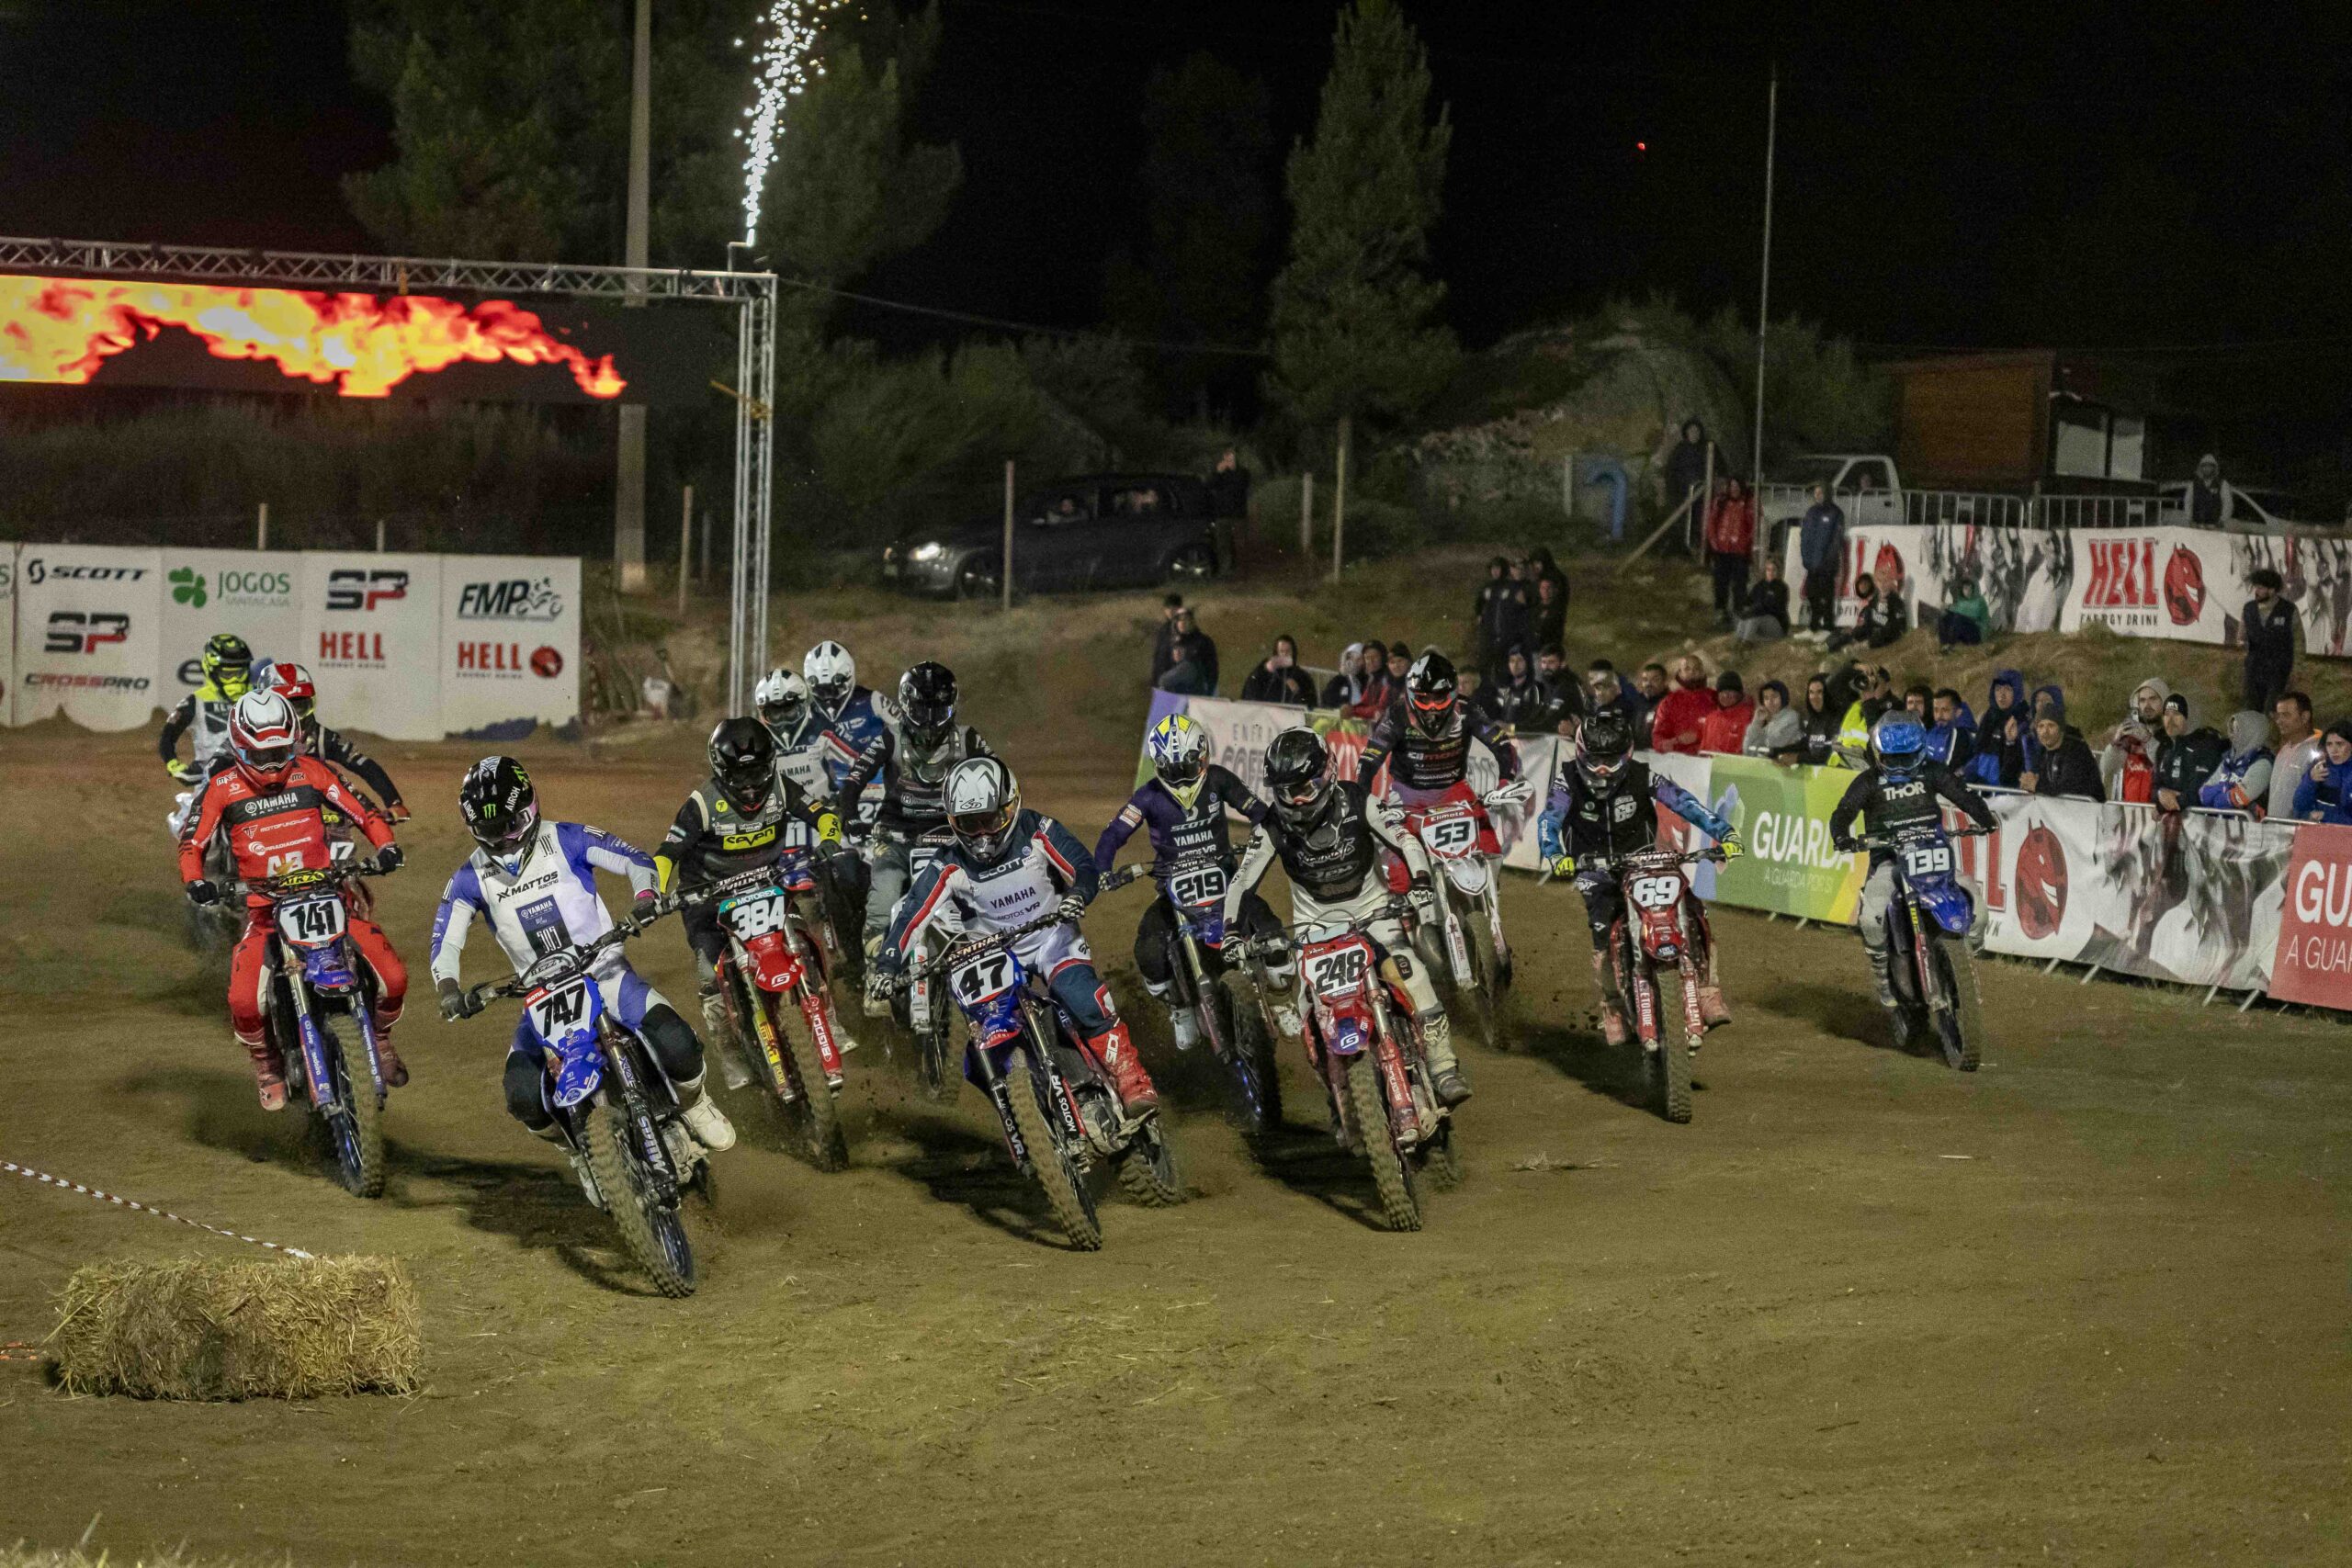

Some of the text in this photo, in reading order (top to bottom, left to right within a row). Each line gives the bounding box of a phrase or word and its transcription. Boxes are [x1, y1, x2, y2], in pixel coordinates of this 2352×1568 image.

[50, 566, 147, 581] SCOTT
[218, 570, 290, 598] JOGOS
[2083, 537, 2158, 608] HELL
[458, 580, 531, 615] FMP
[2126, 613, 2158, 626] DRINK
[320, 632, 385, 660] HELL
[458, 642, 522, 670] HELL
[25, 673, 150, 691] CROSSPRO
[782, 764, 811, 777] AMAHA
[256, 792, 299, 809] YAMAHA
[505, 787, 522, 812] AIROH
[1883, 782, 1927, 801] THOR
[462, 799, 477, 822] AIROH
[1170, 810, 1220, 832] SCOTT
[1174, 830, 1214, 847] YAMAHA
[1435, 821, 1471, 848] 53
[1202, 844, 1216, 853] VR
[1905, 847, 1950, 875] 139
[978, 857, 1022, 879] SCOTT
[511, 871, 559, 897] MATTOS
[1175, 871, 1226, 904] 219
[1634, 875, 1681, 908] 69
[2295, 860, 2352, 928] GU
[527, 901, 553, 915] YAMAHA
[737, 888, 776, 906] MOTOREX
[990, 886, 1036, 909] YAMAHA
[289, 901, 337, 940] 141
[731, 896, 786, 942] 384
[997, 901, 1040, 921] MOTOS VR
[968, 954, 980, 963] VR
[2285, 934, 2298, 965] A
[959, 954, 1007, 1001] 47
[1315, 949, 1367, 994] 248
[526, 989, 545, 1004] MOTUL
[536, 982, 586, 1040] 747
[1105, 1033, 1119, 1066] SIDI
[1050, 1075, 1077, 1132] MOTOS VR
[1011, 1133, 1025, 1155] VR
